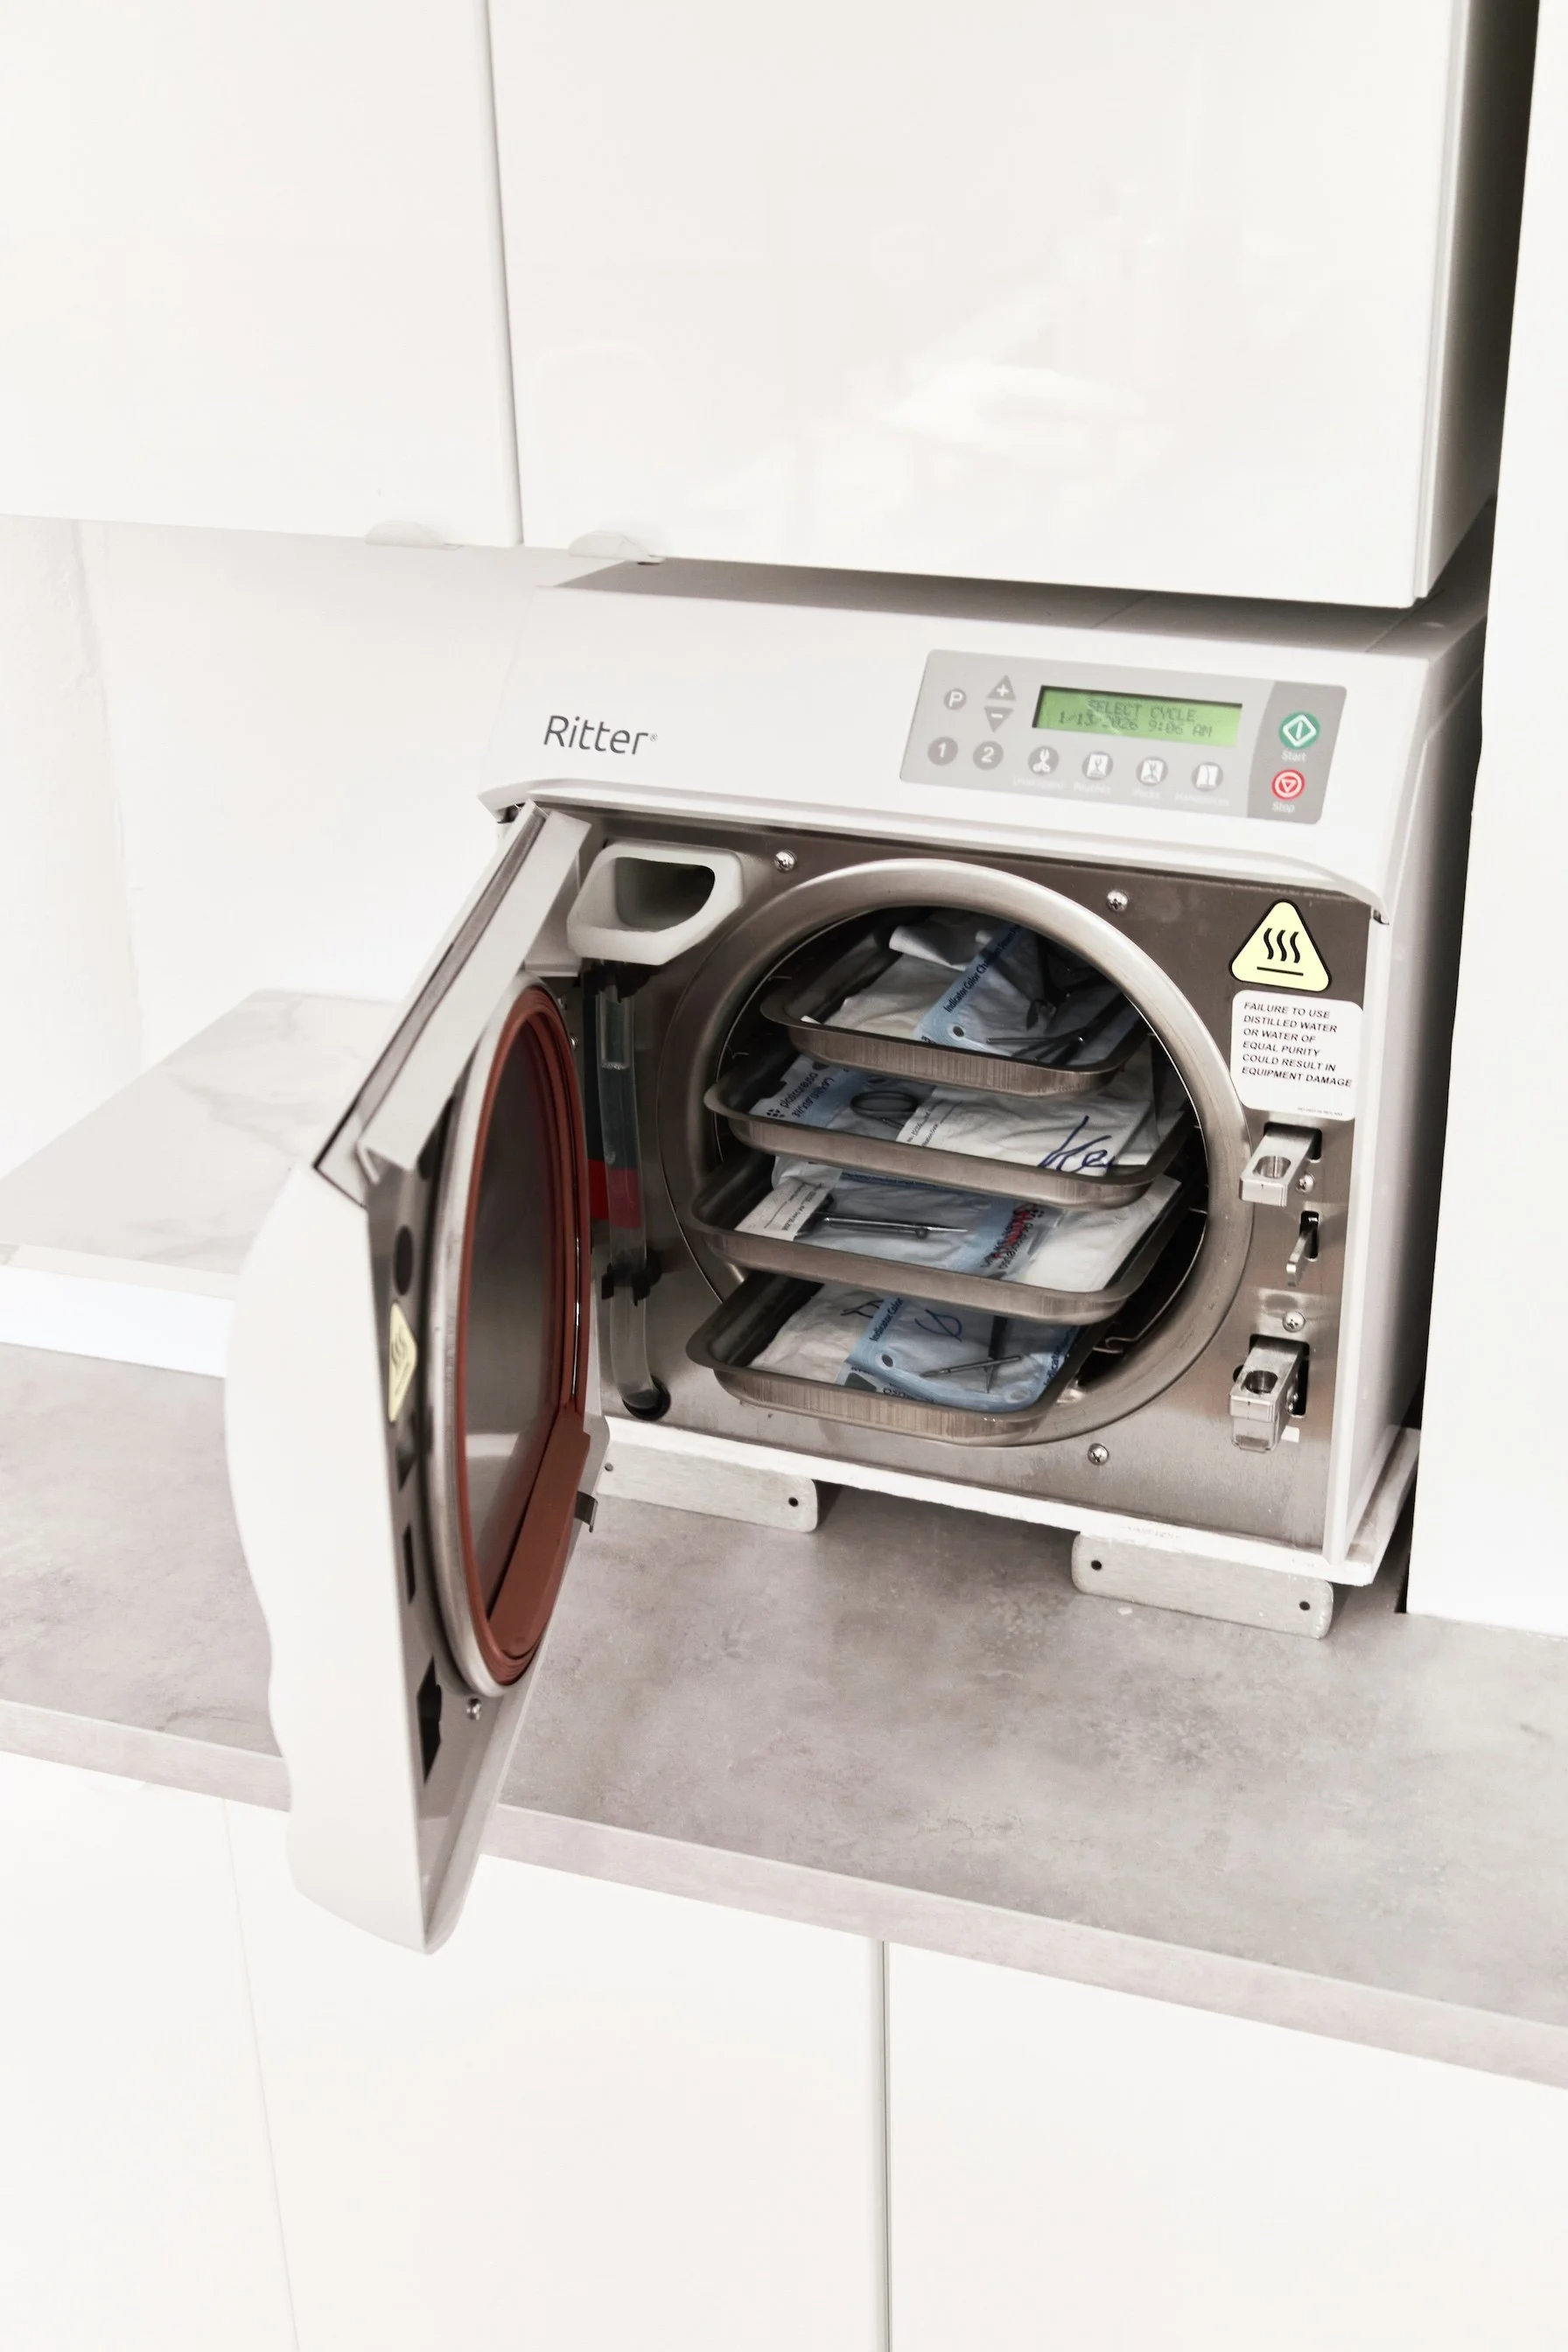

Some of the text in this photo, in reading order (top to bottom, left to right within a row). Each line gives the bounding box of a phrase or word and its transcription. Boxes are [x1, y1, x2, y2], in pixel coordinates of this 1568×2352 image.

[948, 690, 963, 708] P
[1088, 699, 1197, 723] SELECT CYCLE
[1148, 719, 1184, 736] 9:06
[1192, 724, 1214, 738] AM
[938, 742, 946, 759] 1
[981, 746, 995, 763] 2
[1281, 750, 1307, 763] Start
[1271, 801, 1296, 815] Stop
[943, 987, 969, 1013] Indicator
[963, 971, 981, 990] Color
[1243, 1002, 1331, 1018] FAILURE TO USE
[1243, 1015, 1338, 1033] DISTILLED WATER
[1243, 1028, 1316, 1043] OR WATER OF
[1242, 1041, 1321, 1057] EQUAL PURITY
[1242, 1054, 1336, 1073] COULD RESULT IN
[1241, 1067, 1353, 1088] EQUIPMENT DAMAGE
